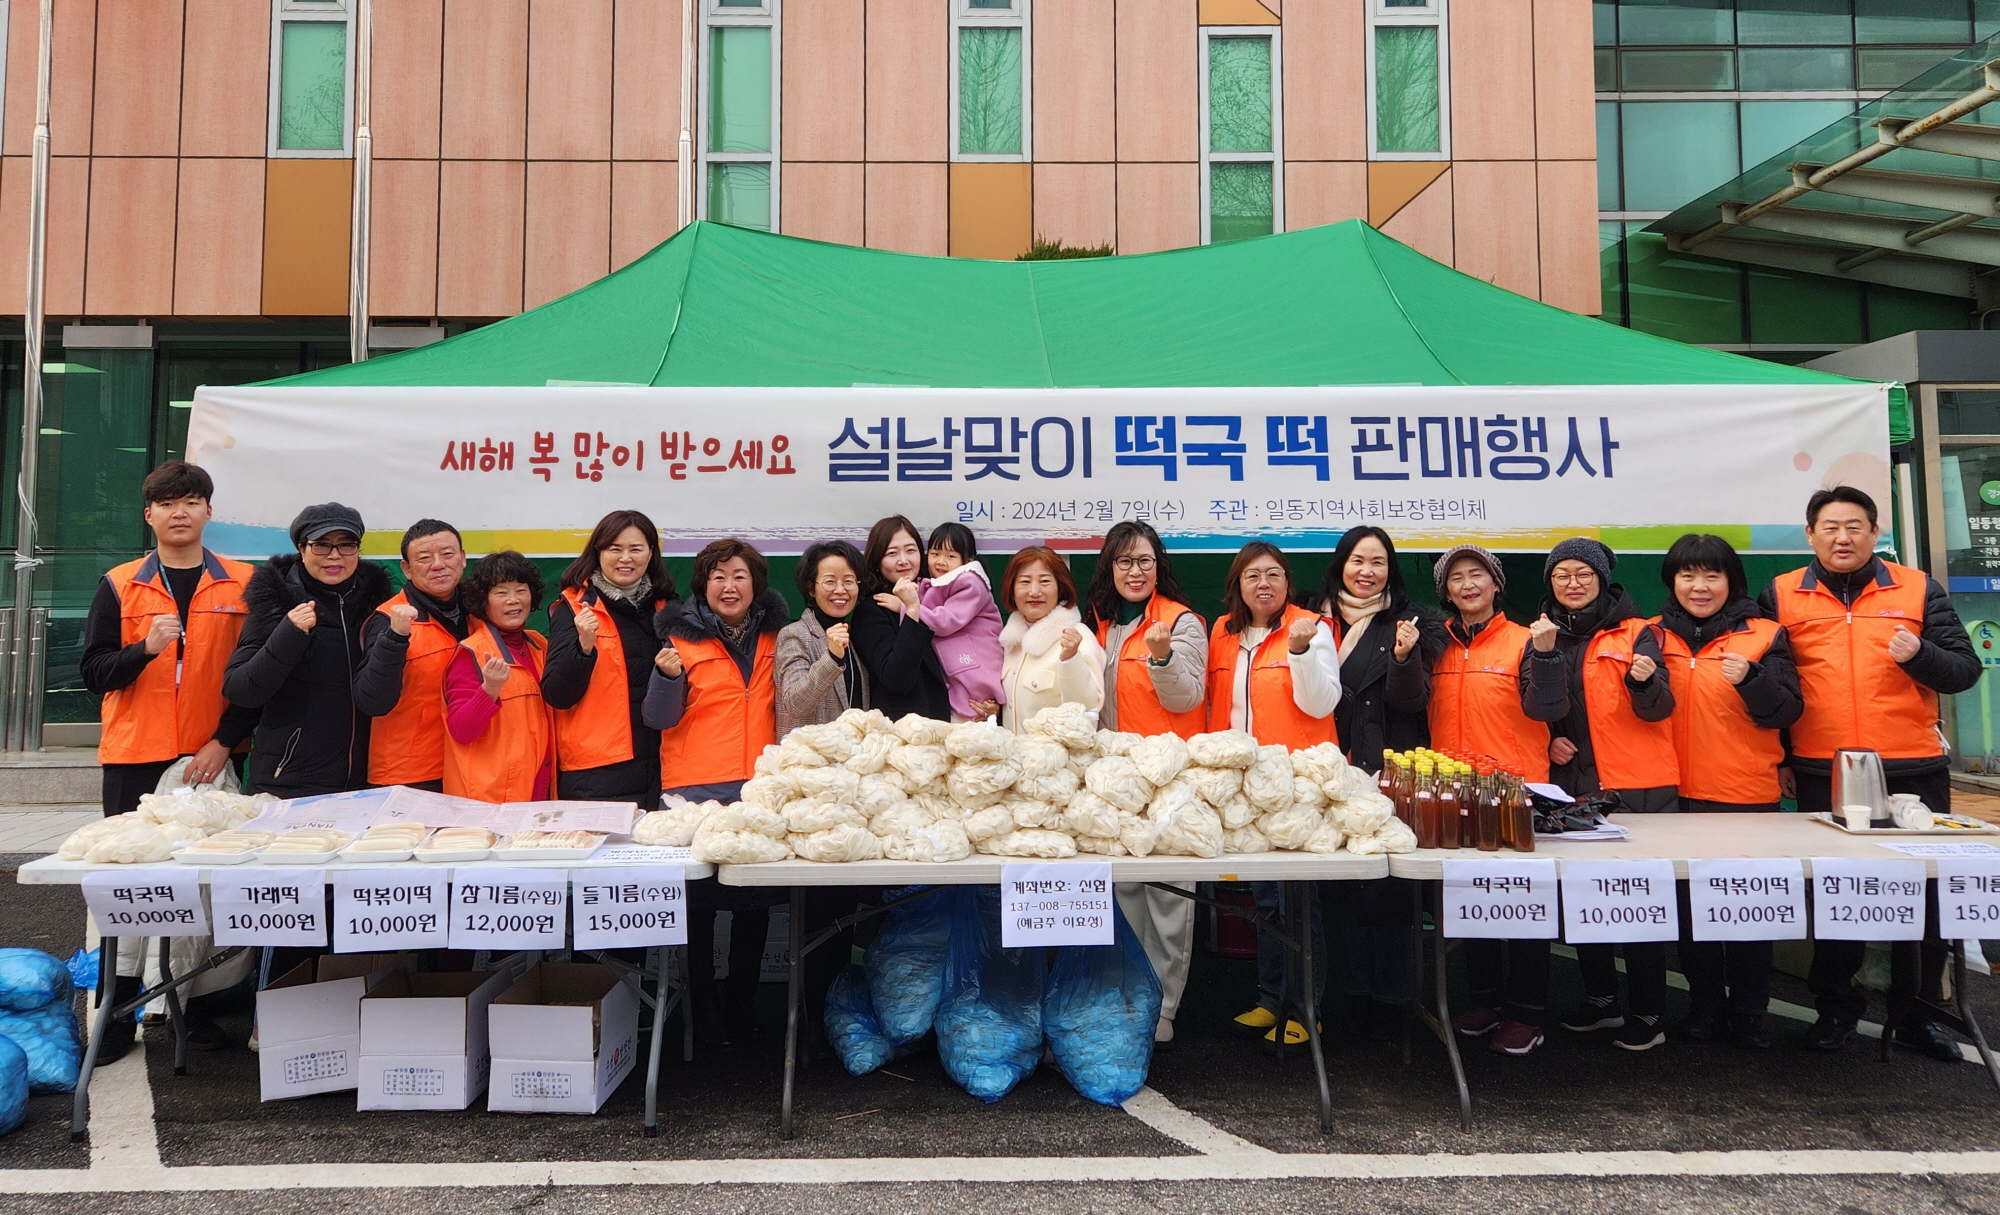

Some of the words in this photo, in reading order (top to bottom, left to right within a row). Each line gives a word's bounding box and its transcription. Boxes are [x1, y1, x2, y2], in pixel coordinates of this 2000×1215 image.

[439, 438, 514, 473] 새해
[529, 431, 560, 481] 복
[573, 431, 644, 482] 많이
[661, 430, 796, 480] 받으세요
[828, 417, 1092, 482] 설날맞이
[1115, 415, 1246, 481] 떡국
[1266, 415, 1330, 481] 떡
[1351, 414, 1619, 481] 판매행사
[956, 499, 994, 522] 일시
[1012, 500, 1075, 522] 2024년
[1083, 500, 1114, 522] 2월
[1119, 500, 1185, 524] 7일(수)
[1209, 499, 1248, 520] 주관
[1265, 498, 1486, 520] 일동지역사회보장협의체
[113, 885, 174, 904] 떡국떡
[582, 883, 682, 904] 들기름(수입)
[1012, 880, 1071, 894] 계좌번호:
[1079, 879, 1106, 892] 신협
[1473, 876, 1531, 893] 떡국떡
[1592, 878, 1650, 897] 가래떡
[1709, 877, 1789, 895] 떡볶이떡
[1823, 876, 1921, 897] 참기름(수입)
[241, 885, 299, 905] 가래떡
[354, 884, 432, 906] 떡볶이떡
[461, 885, 562, 905] 참기름(수입)
[1010, 901, 1108, 911] 137-008-755151
[1459, 904, 1546, 922] 10,000원
[1579, 906, 1667, 926] 10,000원
[1708, 906, 1796, 925] 10,000원
[1829, 906, 1915, 924] 12,000원
[108, 908, 196, 925] 10,000원
[228, 913, 316, 931] 10,000원
[350, 914, 436, 935] 10,000원
[465, 914, 555, 934] 12,000원
[589, 911, 676, 932] 15,000원
[1017, 917, 1055, 930] (예금주
